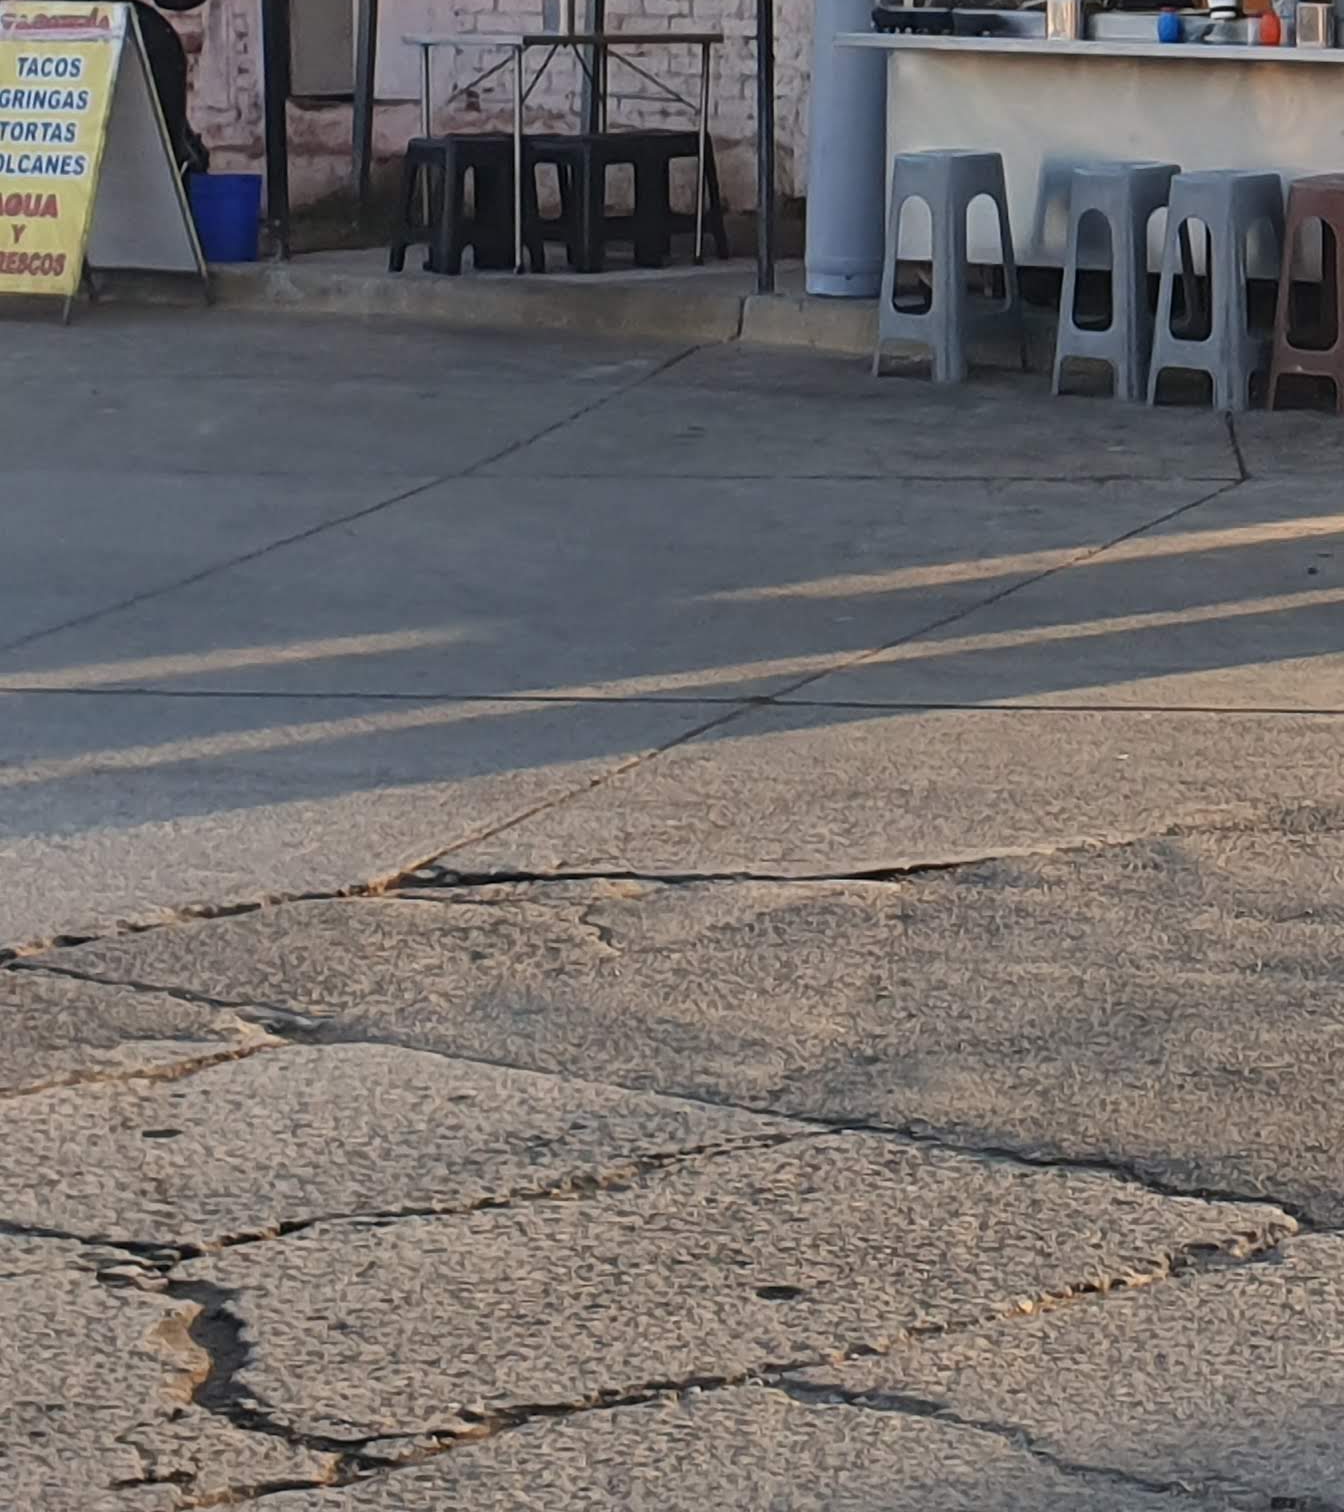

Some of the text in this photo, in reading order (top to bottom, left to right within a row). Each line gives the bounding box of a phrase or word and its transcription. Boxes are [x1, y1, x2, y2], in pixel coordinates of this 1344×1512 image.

[17, 56, 82, 78] TACOS
[0, 88, 89, 111] GRINGAS
[0, 120, 77, 144] TORTAS
[11, 224, 26, 244] Y
